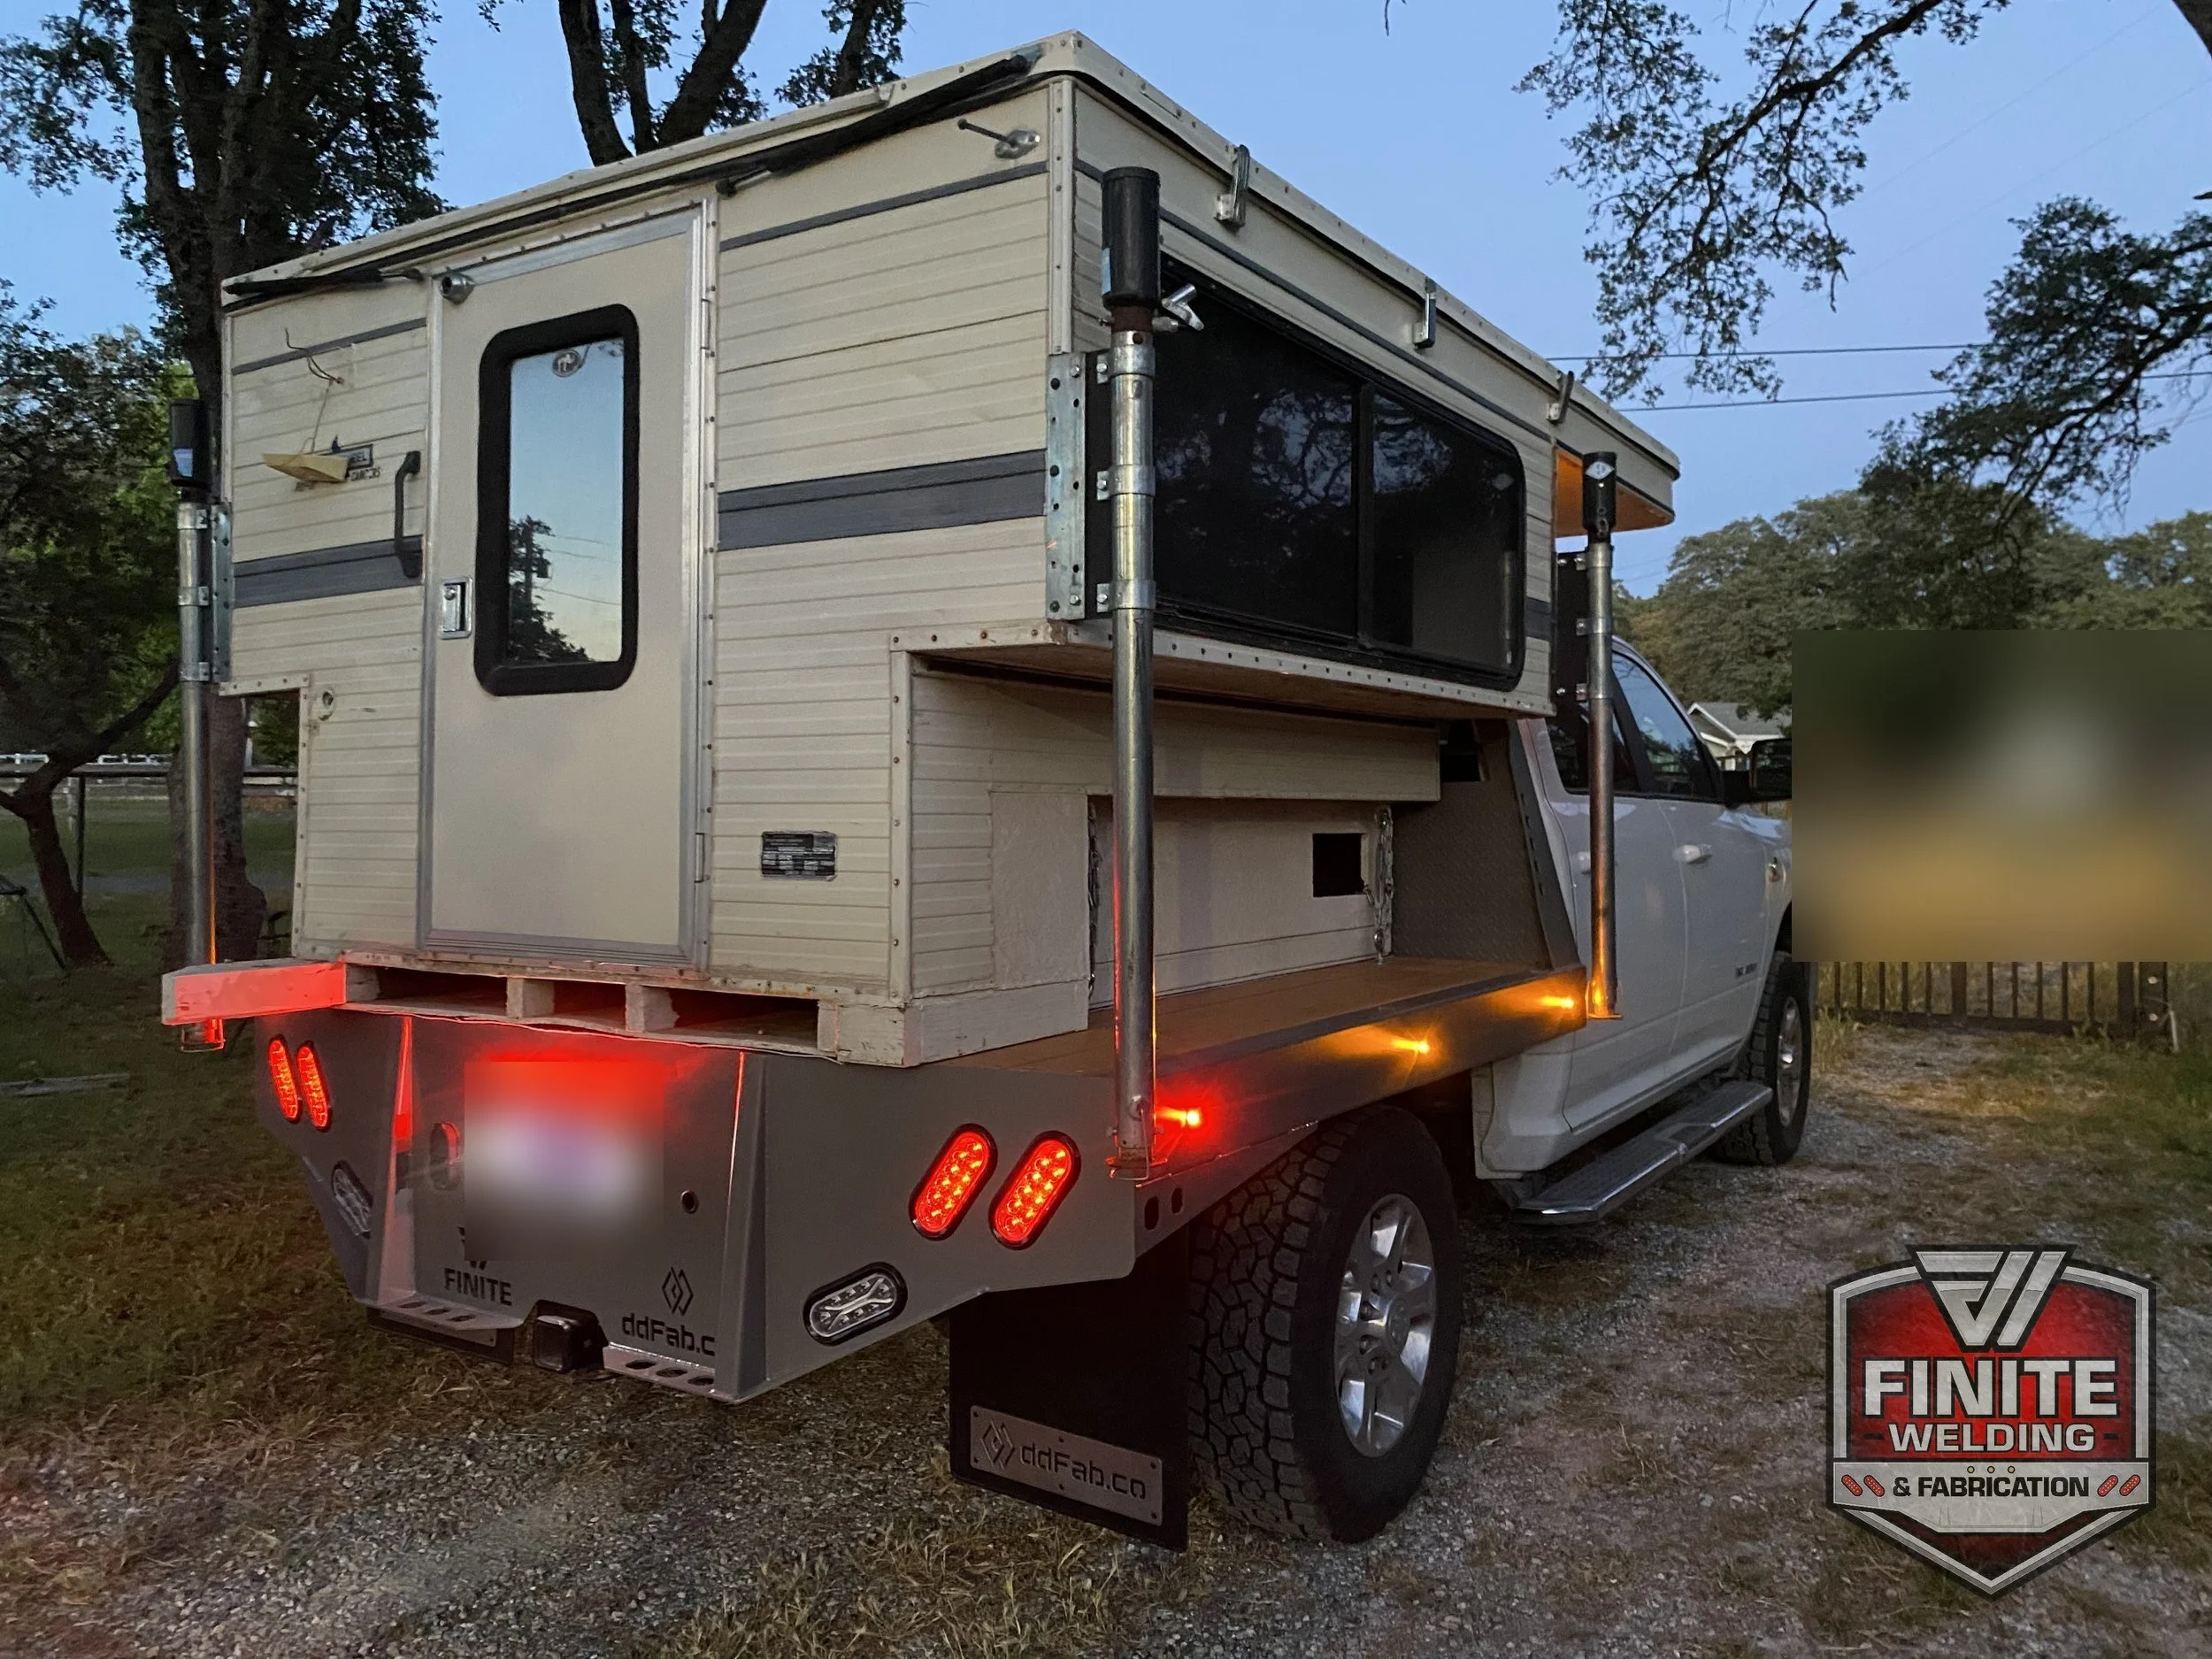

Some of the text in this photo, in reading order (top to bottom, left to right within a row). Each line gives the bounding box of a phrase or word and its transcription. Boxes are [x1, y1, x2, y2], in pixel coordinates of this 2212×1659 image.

[444, 1268, 512, 1306] FINITE
[622, 1312, 716, 1356] ddFab.c
[1020, 1443, 1146, 1500] ddFab.co
